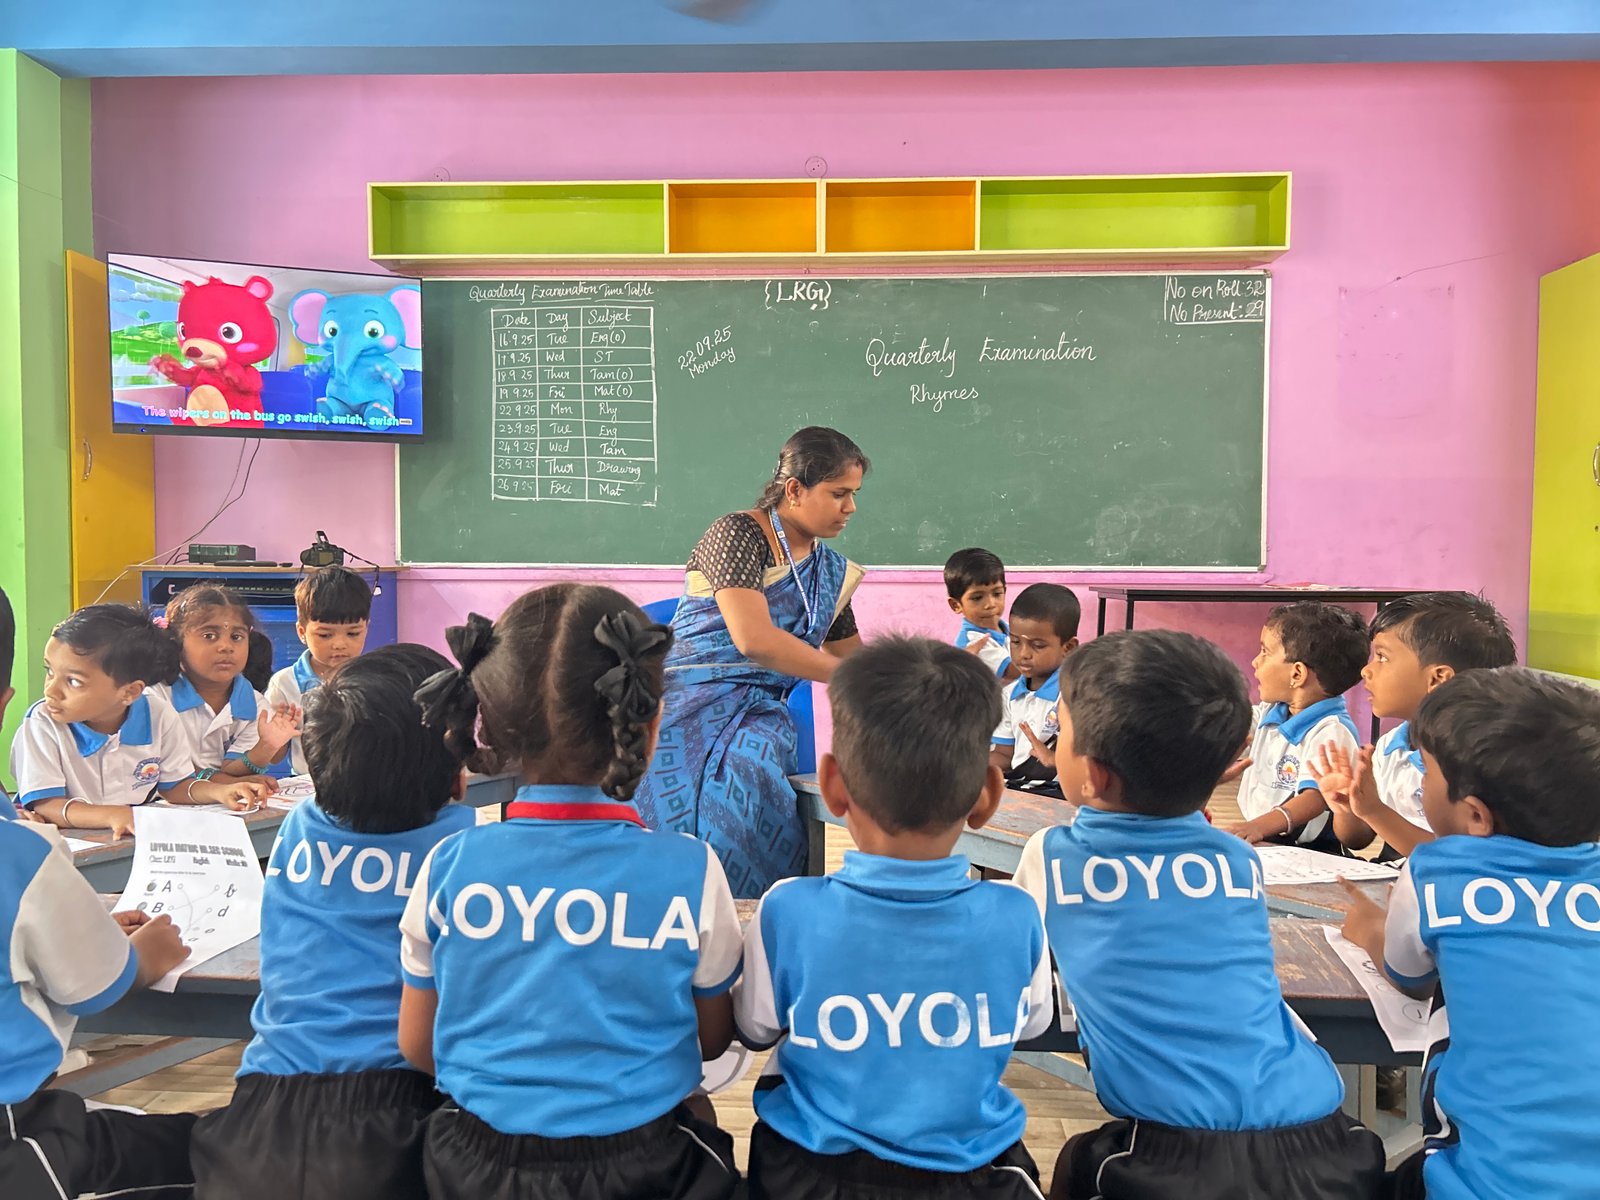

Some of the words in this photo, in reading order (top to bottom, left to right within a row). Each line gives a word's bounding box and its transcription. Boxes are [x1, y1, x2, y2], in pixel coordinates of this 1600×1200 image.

[469, 283, 526, 306] Quarterly
[531, 281, 598, 299] Examination
[599, 283, 624, 297] Time
[624, 281, 655, 297] Table
[1167, 275, 1186, 300] No
[1191, 285, 1213, 300] on
[587, 308, 632, 330] Subject
[1169, 301, 1188, 322] No
[502, 312, 531, 327] Date
[545, 312, 569, 331] Day
[546, 333, 569, 344] Tue
[546, 350, 565, 362] Wed
[865, 336, 957, 378] Quarterly
[979, 331, 1097, 362] Examination
[688, 346, 736, 379] Monday
[543, 367, 570, 380] Thur
[549, 386, 566, 398] Fri
[910, 383, 979, 413] Rhymes
[141, 405, 167, 417] The
[168, 407, 210, 420] wipers
[212, 410, 228, 419] on
[229, 409, 252, 420] the
[253, 409, 276, 421] bus
[277, 413, 292, 425] go
[293, 412, 330, 425] swish,
[331, 413, 367, 426] swish,
[550, 402, 574, 416] Mon
[599, 402, 618, 424] Rhy
[549, 422, 573, 434] Tue
[599, 425, 618, 446] Eng
[549, 439, 570, 452] Wed
[600, 442, 627, 456] Tam
[597, 460, 642, 482] Drawing
[550, 480, 572, 495] Fri
[600, 483, 626, 497] Mat
[162, 880, 172, 893] A
[151, 902, 164, 913] B
